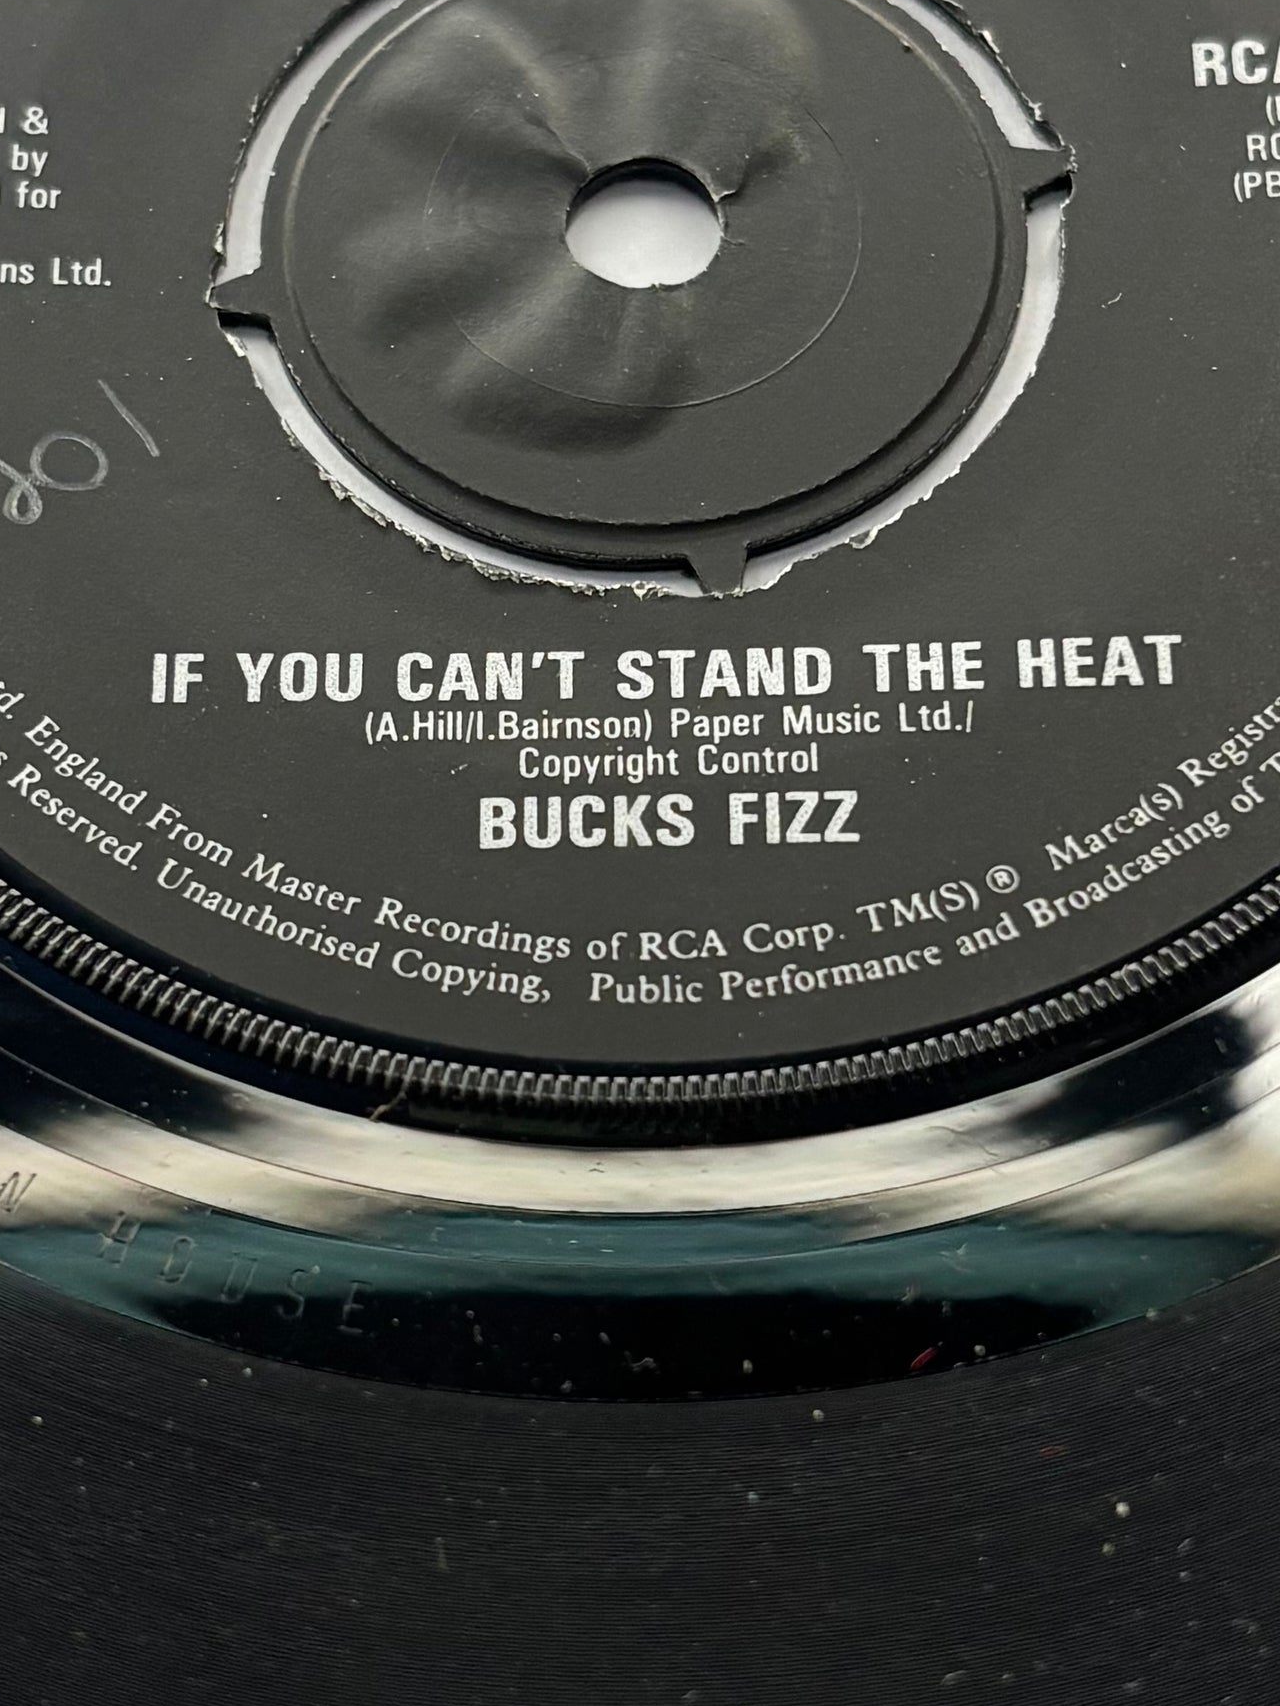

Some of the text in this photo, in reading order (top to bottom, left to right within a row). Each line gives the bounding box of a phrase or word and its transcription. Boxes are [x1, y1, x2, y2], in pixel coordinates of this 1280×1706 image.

[21, 106, 49, 135] &
[11, 144, 48, 177] by
[17, 181, 61, 209] for
[52, 257, 112, 286] Ltd.
[151, 634, 1182, 704] IF YOU CAN'T STAND THE HEAT
[670, 705, 764, 744] Paper
[782, 703, 881, 738] Music
[519, 742, 819, 784] Copyright Control
[24, 715, 148, 815] England
[145, 802, 234, 867] From
[241, 853, 362, 916] Master
[374, 896, 571, 963] Recordings
[586, 931, 628, 961] of
[639, 929, 728, 961] RCA
[743, 921, 846, 954] Corp.
[855, 879, 981, 933] TM(S)
[1044, 783, 1184, 871] Marca(s)
[480, 790, 861, 850] BUCKS FIZZ
[7, 763, 143, 872] Reserved.
[155, 857, 381, 970] Unauthorised
[391, 947, 552, 1004] Copying,
[589, 971, 704, 1004] Public
[718, 943, 944, 1001] Performance
[954, 912, 1021, 958] and
[1022, 809, 1232, 930] Broadcasting
[1230, 775, 1267, 815] of
[95, 1210, 373, 1334] HOUSE
